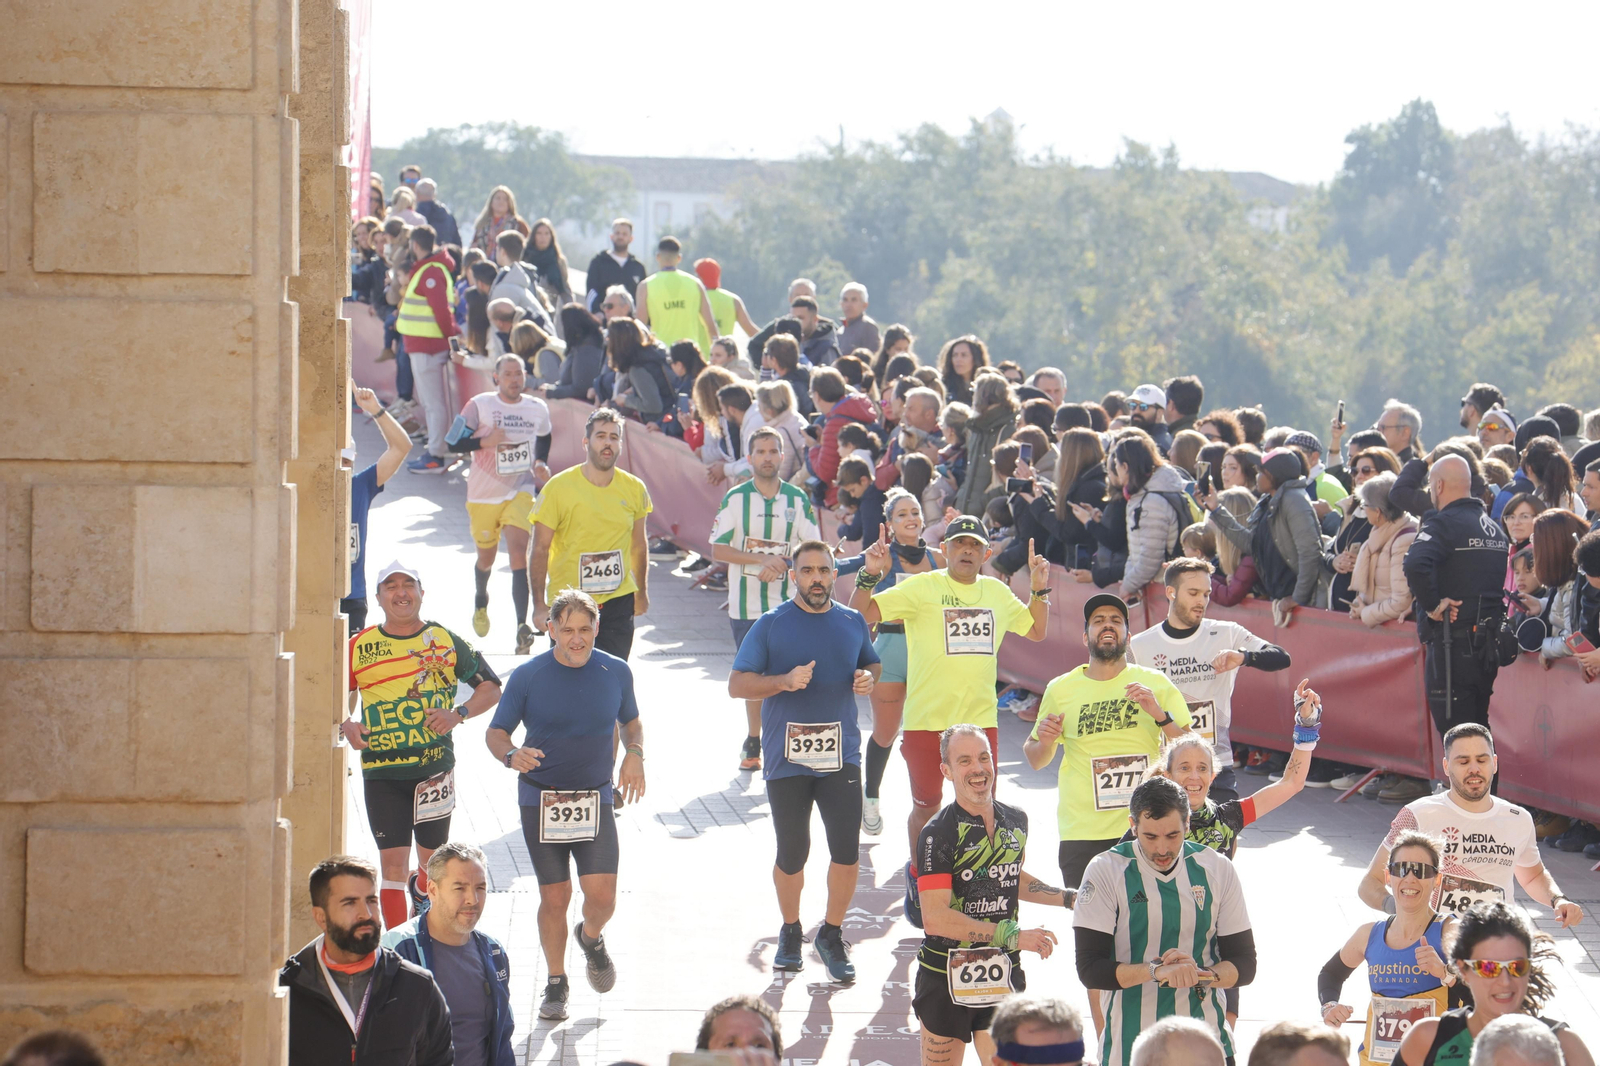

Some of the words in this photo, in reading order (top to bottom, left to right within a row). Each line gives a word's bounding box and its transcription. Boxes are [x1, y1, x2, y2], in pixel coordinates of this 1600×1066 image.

[664, 300, 685, 310] UME
[500, 450, 528, 462] 3899
[583, 563, 620, 578] 2468
[949, 622, 991, 637] 2365
[357, 640, 380, 655] 101
[359, 648, 393, 662] RONDA
[1169, 656, 1198, 667] MEDIA
[1077, 698, 1140, 738] NIKE
[791, 737, 836, 753] 3932
[550, 806, 590, 822] 3931
[1462, 833, 1496, 843] MEDIA
[1444, 842, 1459, 854] 37
[1463, 842, 1516, 856] MARATÓN
[1462, 856, 1497, 864] CÓRDOBA
[960, 964, 1003, 984] 620
[1368, 961, 1431, 979] agustinos
